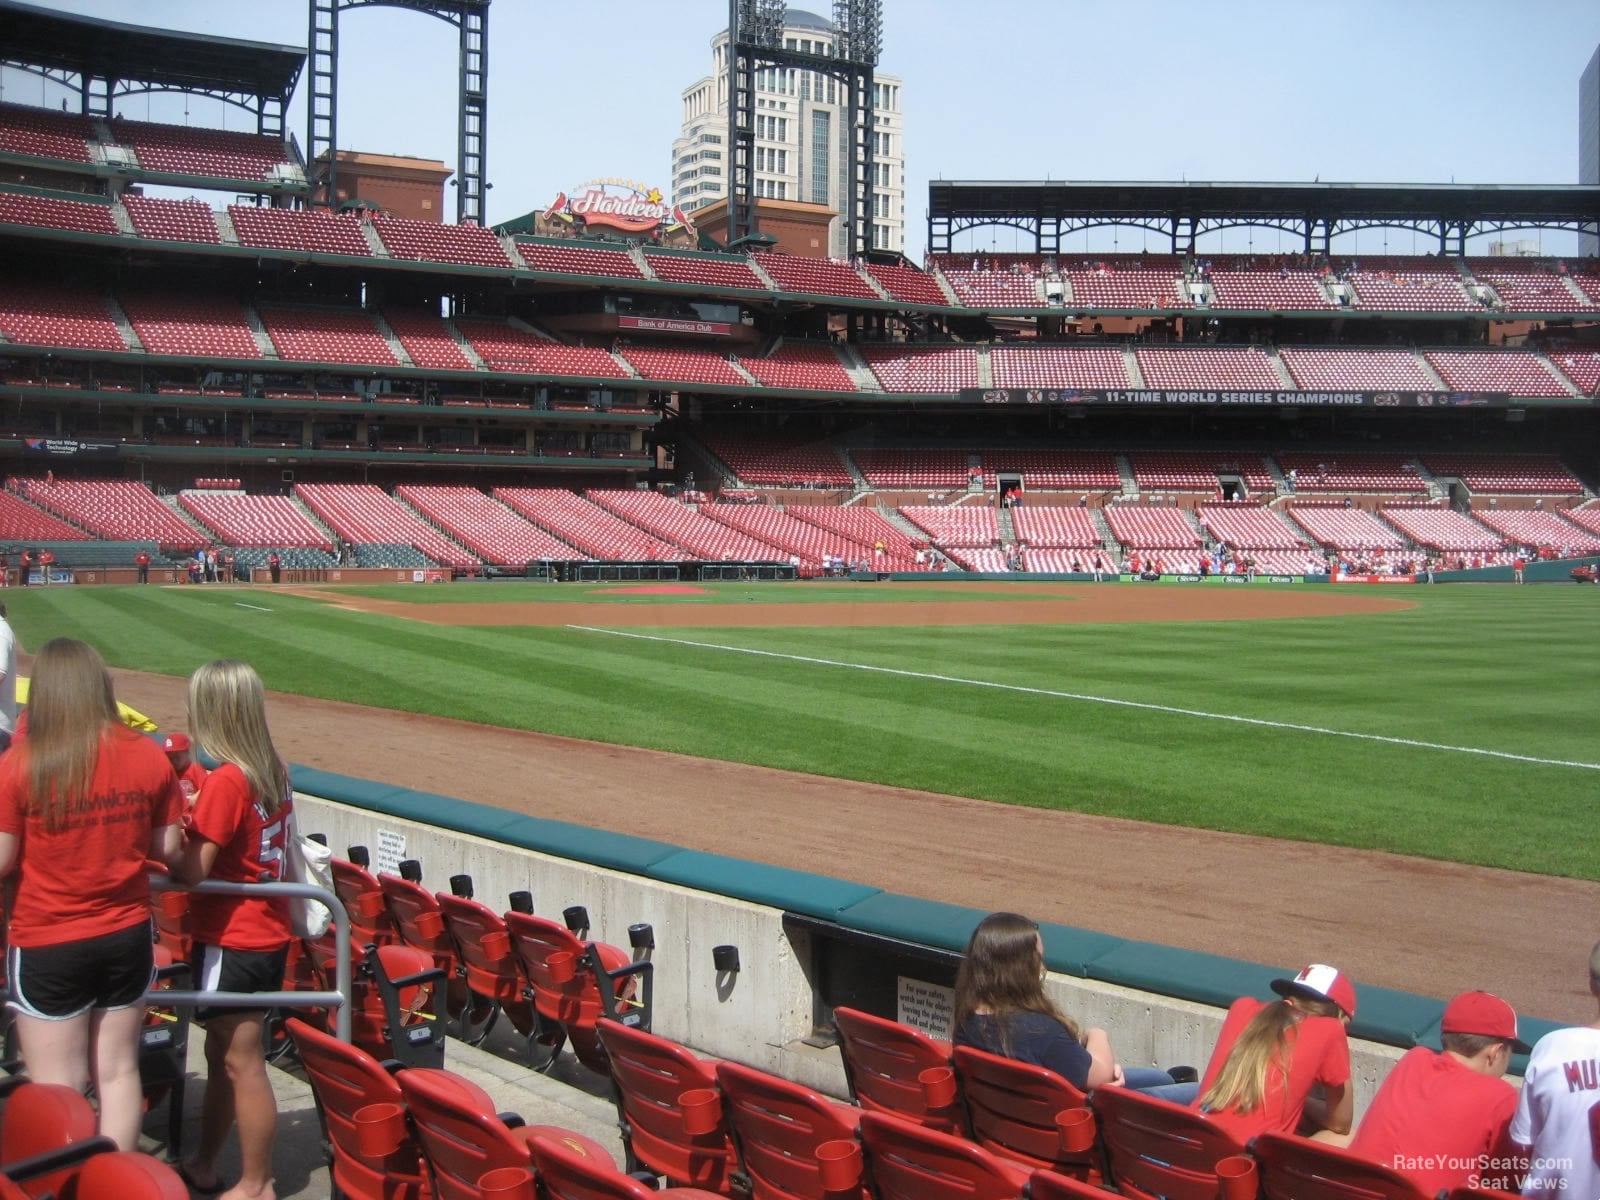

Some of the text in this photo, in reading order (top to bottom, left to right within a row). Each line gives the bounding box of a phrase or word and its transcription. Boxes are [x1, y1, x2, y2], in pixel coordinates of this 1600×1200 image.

[637, 319, 712, 332] Bank of America Club
[1106, 391, 1161, 402] 11-TIME
[1165, 391, 1217, 403] WORLD
[1221, 392, 1272, 404] SERIES
[1276, 392, 1364, 405] CHAMPIONS
[46, 444, 78, 452] Technology
[906, 983, 914, 992] For
[916, 987, 927, 996] your
[925, 998, 934, 1008] for
[902, 1003, 951, 1025] leaving the playing
[906, 1015, 946, 1033] field and please
[1563, 1058, 1600, 1093] MU
